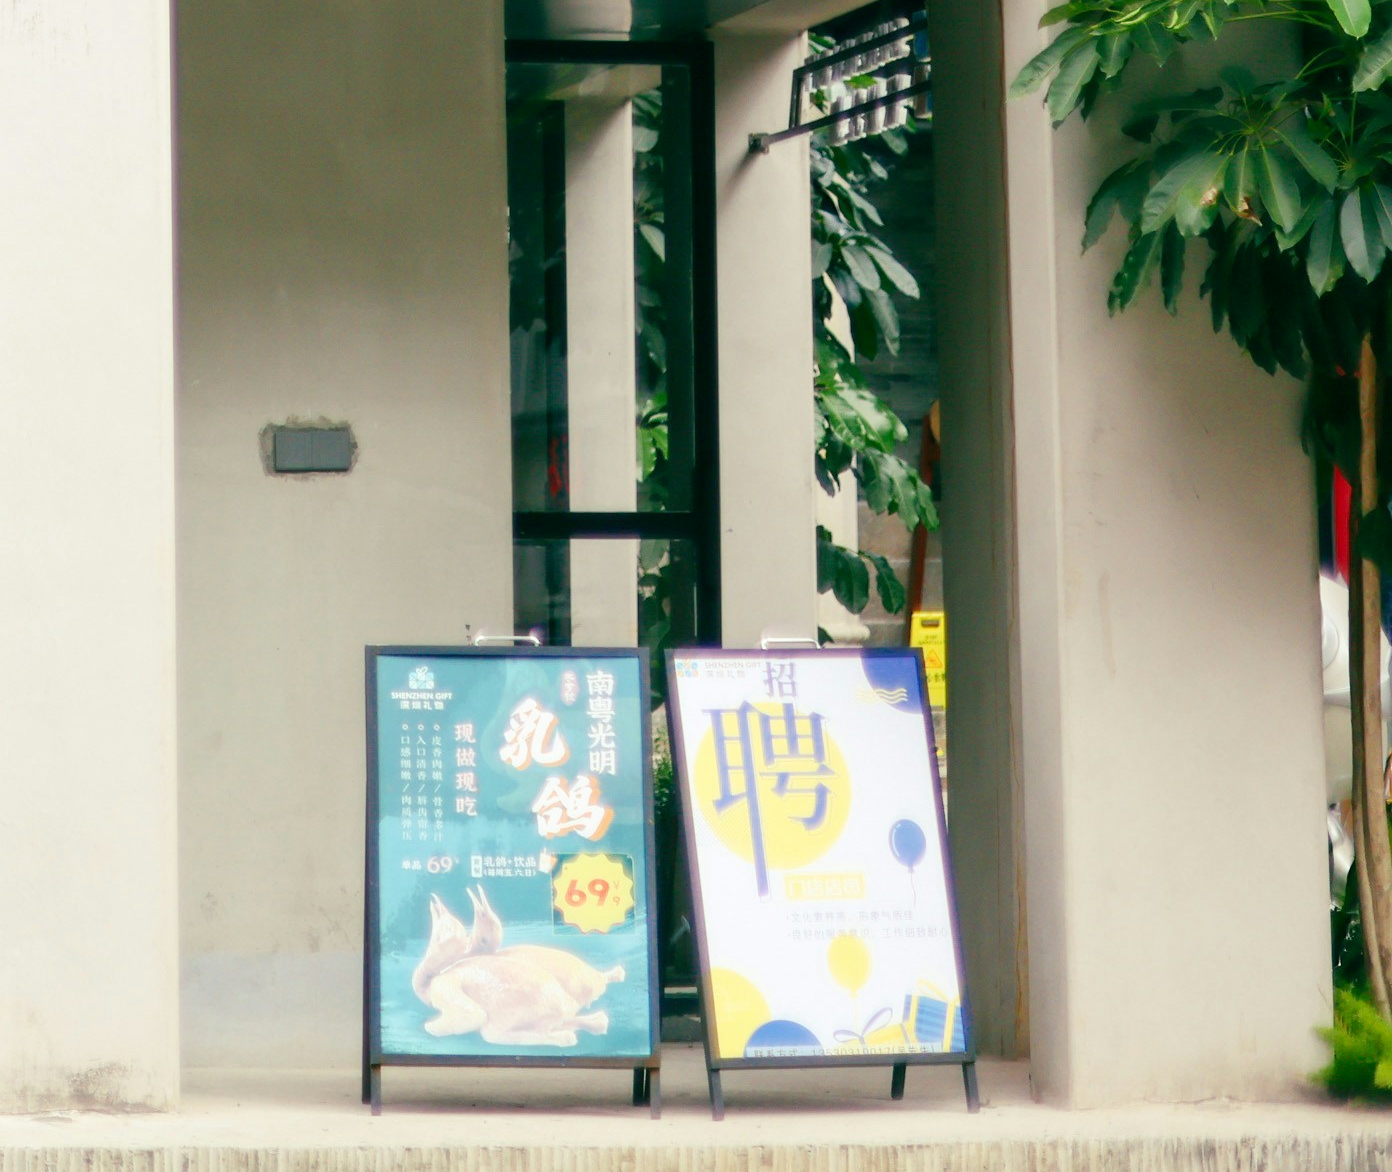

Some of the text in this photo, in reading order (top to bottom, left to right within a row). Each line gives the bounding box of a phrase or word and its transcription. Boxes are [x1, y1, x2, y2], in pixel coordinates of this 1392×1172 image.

[391, 691, 453, 700] SHENZHEN GIFT
[586, 670, 617, 776] 南粤光明
[454, 723, 478, 817] 现做现吃
[401, 859, 422, 870] 单品
[427, 856, 453, 874] 69
